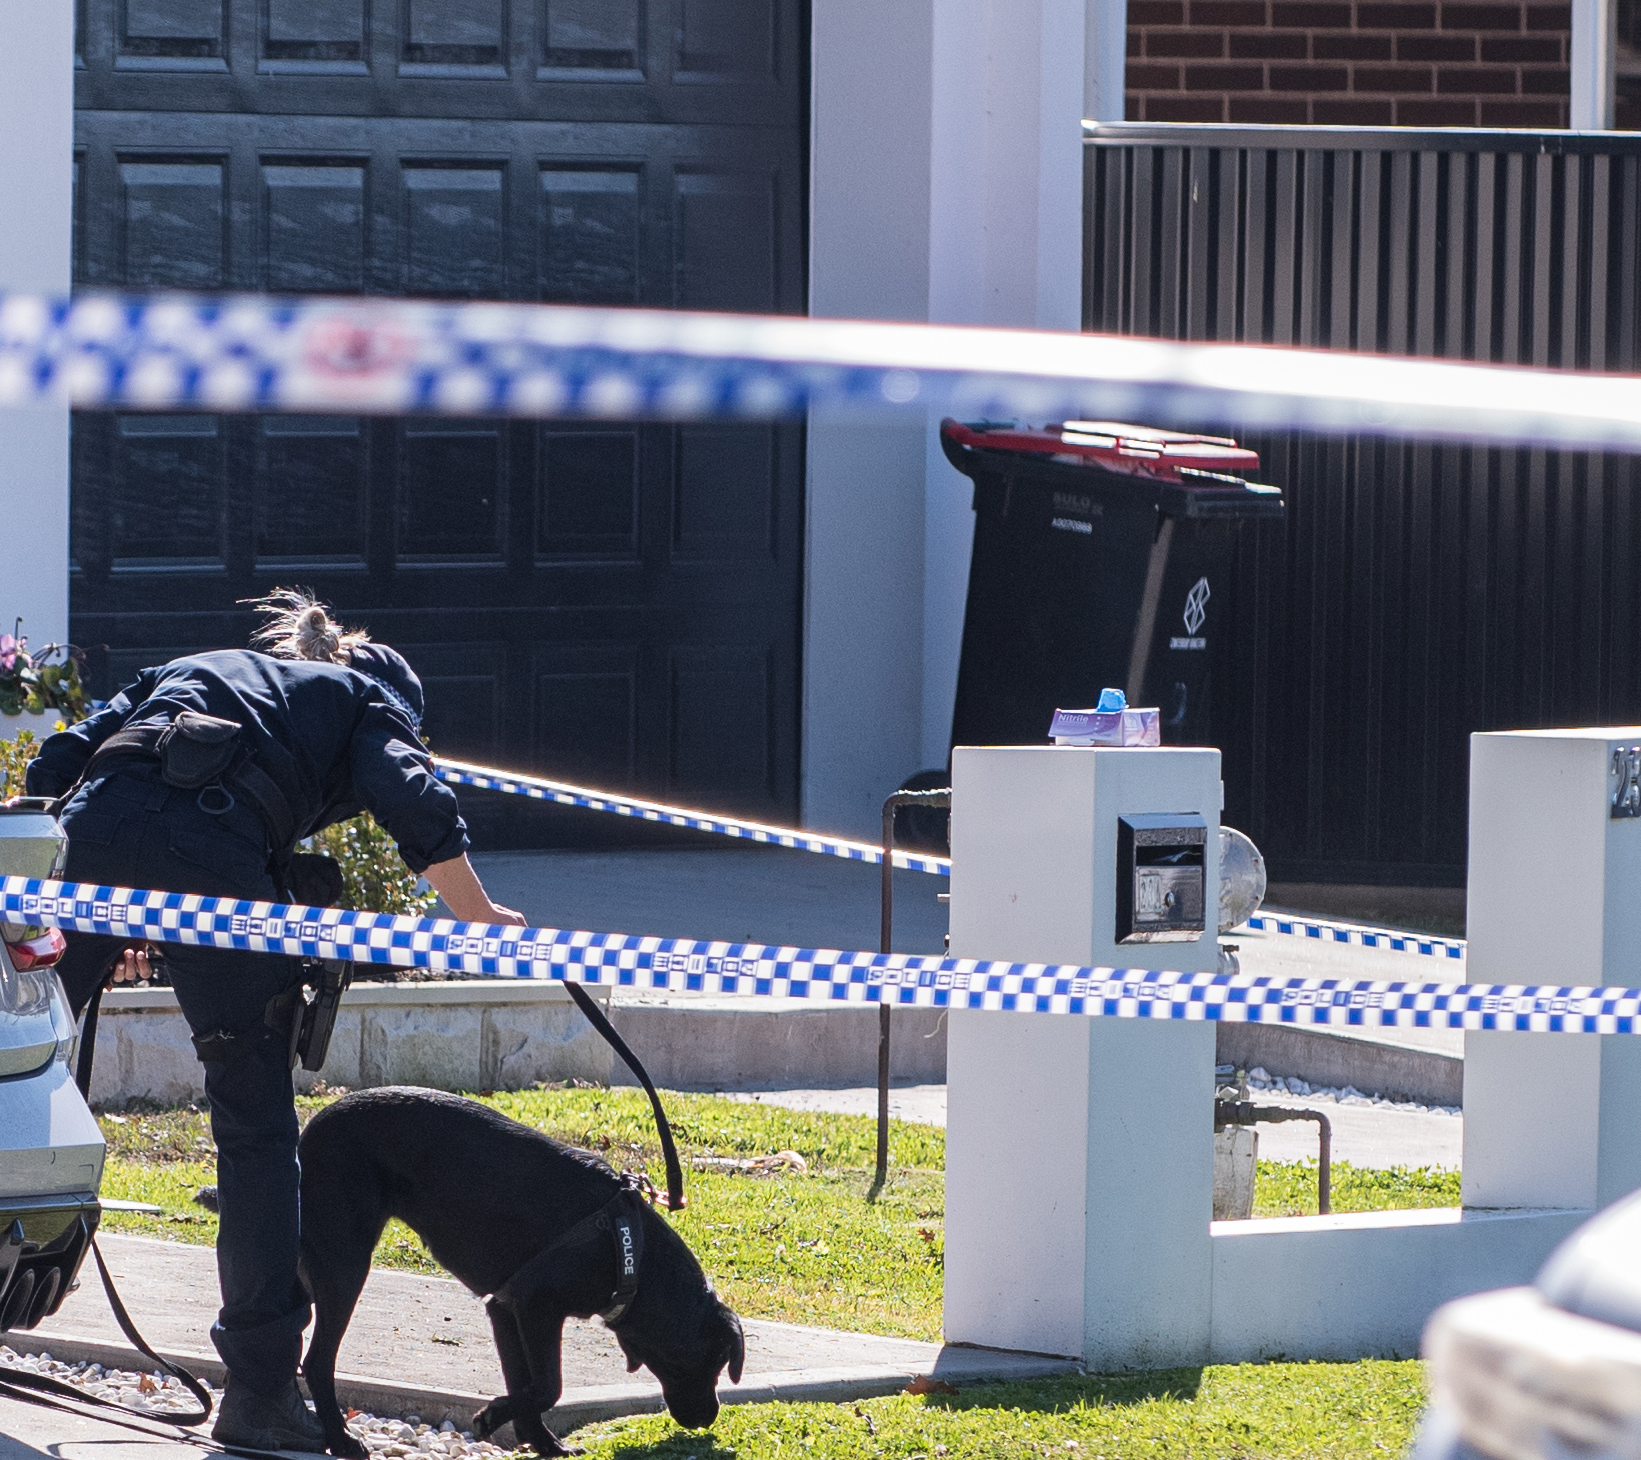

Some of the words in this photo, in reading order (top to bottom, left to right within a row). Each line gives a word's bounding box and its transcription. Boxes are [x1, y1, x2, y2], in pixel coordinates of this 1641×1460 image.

[1058, 714, 1089, 723] Nitrile
[21, 894, 128, 922] POLICE
[447, 935, 553, 960] POLICE
[867, 966, 972, 990] POLICE
[1281, 987, 1384, 1009] POLICE
